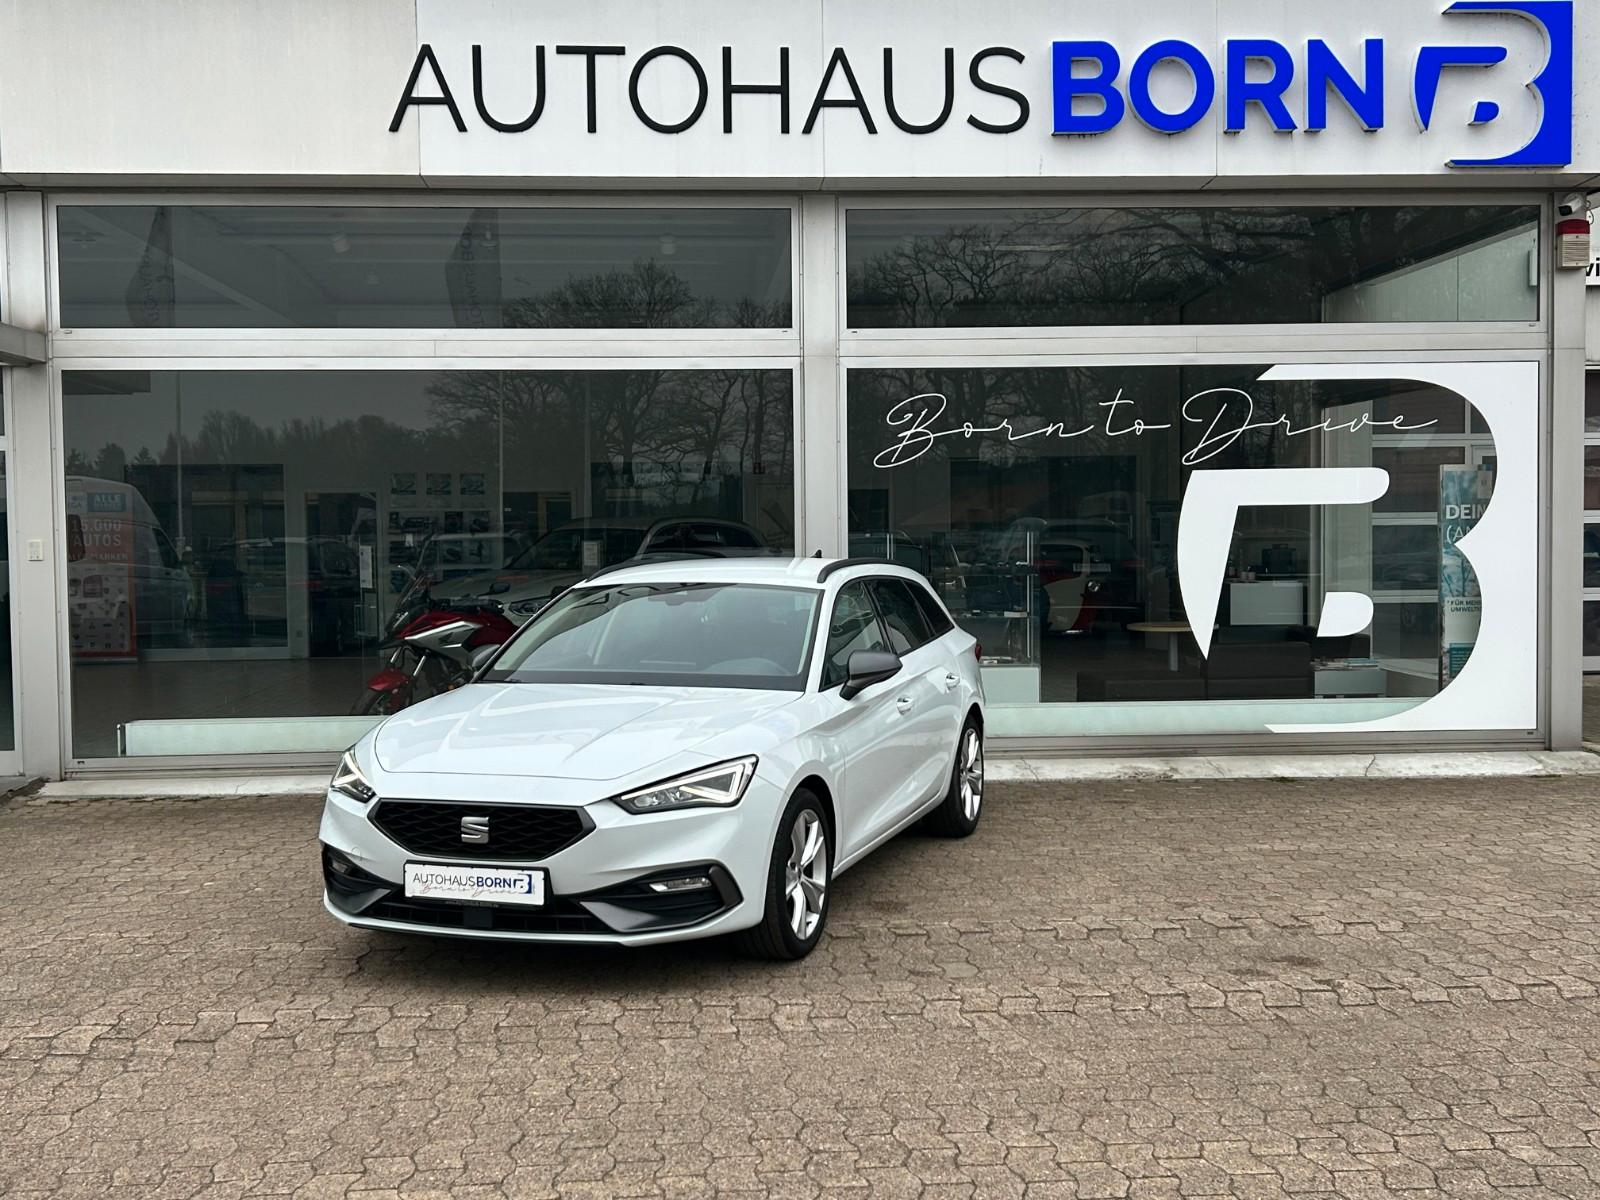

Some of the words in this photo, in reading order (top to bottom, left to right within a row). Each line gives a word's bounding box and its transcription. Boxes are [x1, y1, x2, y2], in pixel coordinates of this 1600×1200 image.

[873, 393, 1094, 468] Born
[1099, 388, 1171, 436] to
[1182, 388, 1438, 465] Drive
[73, 534, 121, 546] AUTOS
